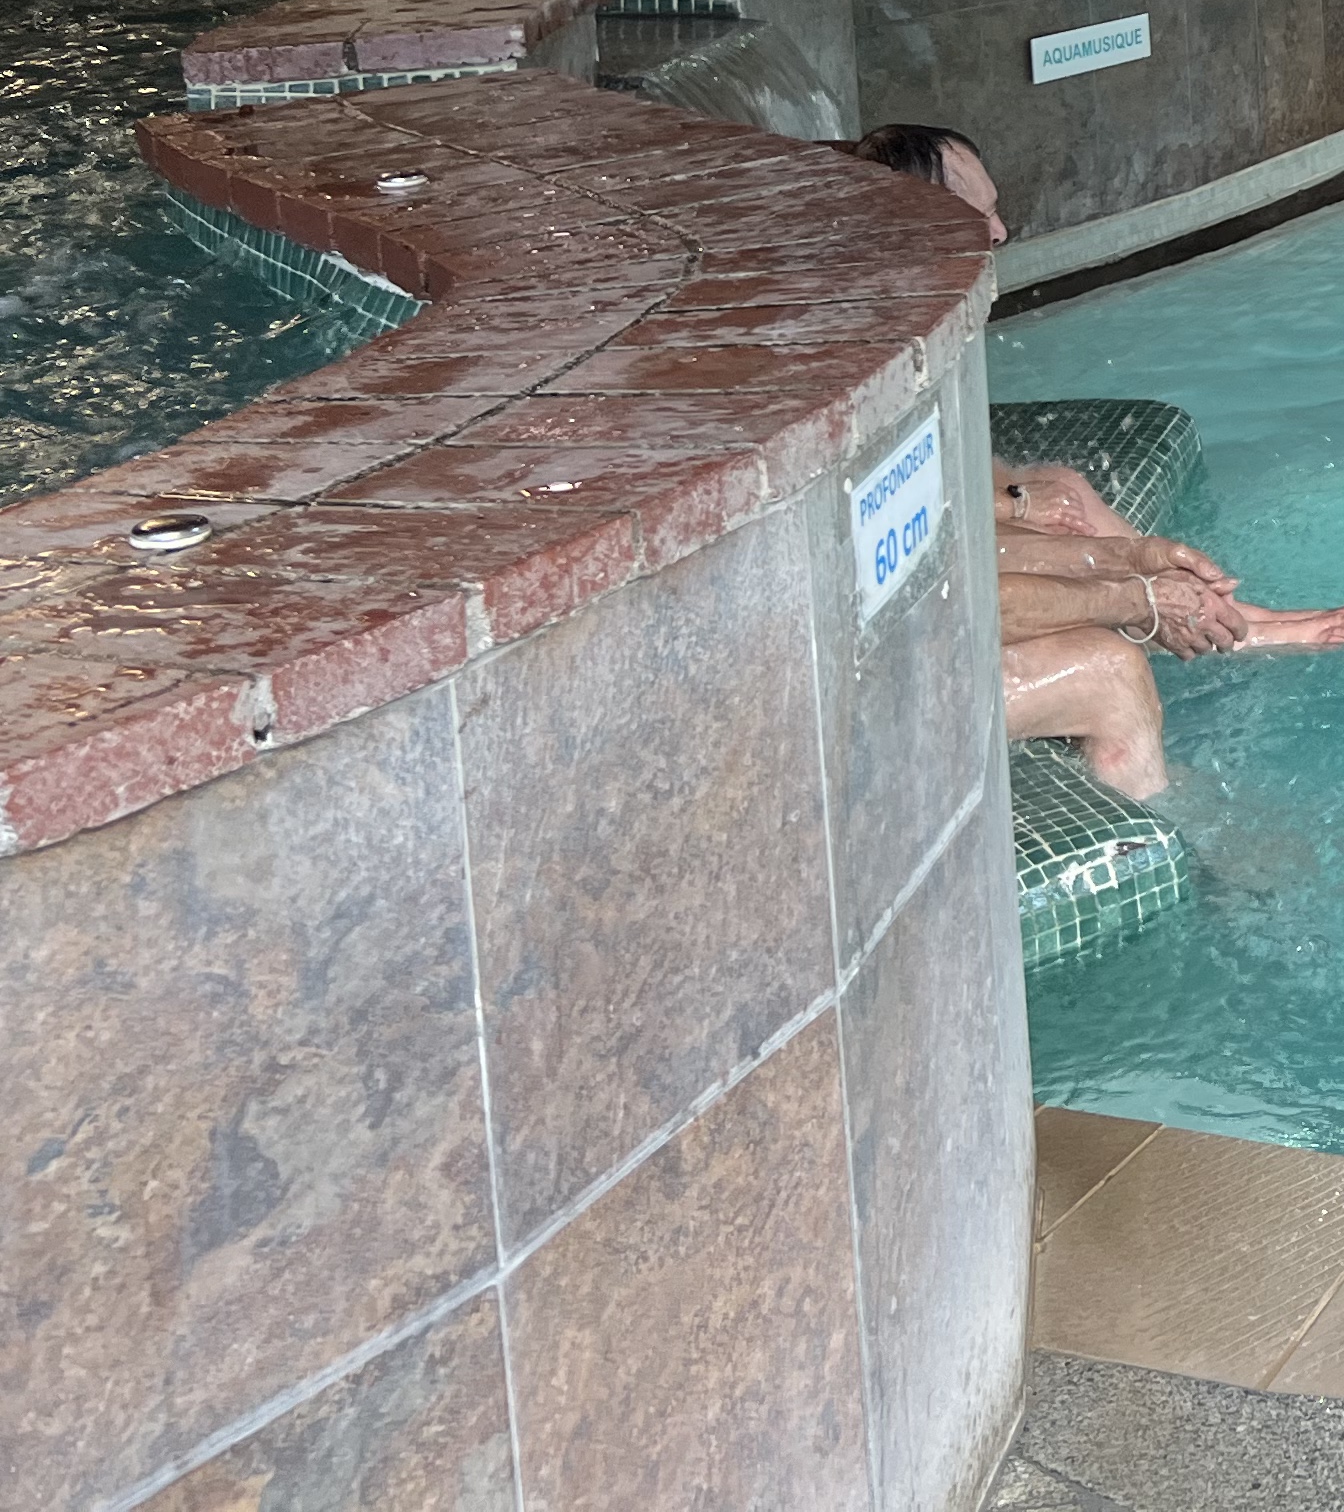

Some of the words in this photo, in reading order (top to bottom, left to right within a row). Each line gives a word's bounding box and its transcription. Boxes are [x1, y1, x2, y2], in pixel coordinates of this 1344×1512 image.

[1043, 28, 1143, 67] AQUAMUSIQUE
[859, 433, 934, 526] PROFONDEUR
[875, 528, 898, 585] 60
[903, 505, 928, 557] cm
